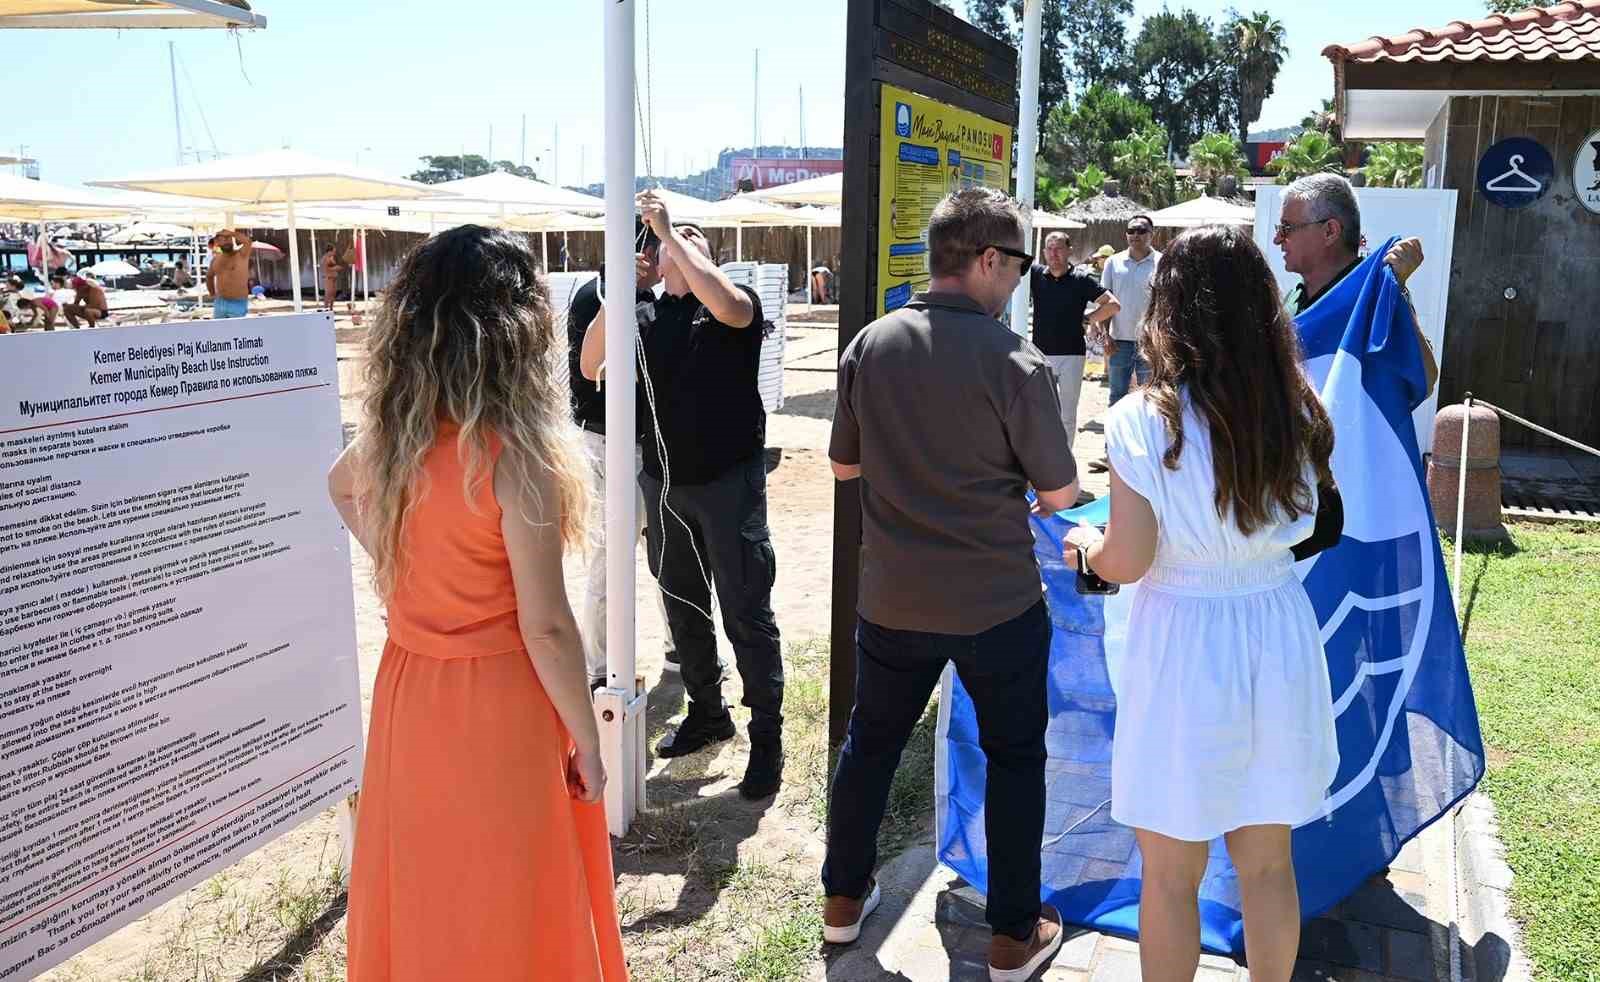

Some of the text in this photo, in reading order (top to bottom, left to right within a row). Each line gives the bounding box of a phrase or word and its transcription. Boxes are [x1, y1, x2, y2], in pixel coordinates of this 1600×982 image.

[94, 336, 263, 364] Kemer Belediyesi Plaj Kullanım Talimatı
[90, 354, 269, 385] Kemer Municipality Beach Use Instruction
[19, 393, 111, 418] Муниципальитет
[114, 389, 148, 405] города
[149, 384, 179, 398] Кемер
[180, 379, 219, 396] Правила
[220, 378, 231, 388] по
[232, 370, 294, 386] использованию
[1, 438, 94, 458] masks in separate boxes
[15, 484, 48, 498] of social
[25, 526, 51, 537] smoke
[52, 523, 62, 531] on
[63, 520, 76, 528] the
[76, 514, 101, 525] beach.
[131, 504, 143, 513] the
[39, 512, 63, 523] dikkat
[12, 566, 51, 581] relaxation
[52, 562, 66, 571] use
[67, 559, 79, 567] the
[4, 616, 20, 625] use
[9, 653, 30, 665] enter
[31, 649, 44, 658] the
[45, 644, 59, 653] sea
[60, 641, 68, 649] in
[3, 700, 13, 708] to
[14, 694, 31, 705] stay
[41, 686, 54, 695] the
[55, 677, 77, 690] beach
[78, 664, 112, 681] overnight
[33, 726, 49, 738] into
[49, 722, 61, 732] the
[77, 708, 99, 720] where
[143, 685, 158, 695] high
[24, 812, 37, 822] the
[38, 802, 60, 816] entire
[60, 791, 83, 805] beach
[92, 770, 127, 792] monitored
[47, 918, 76, 937] Thank
[77, 908, 95, 924] you
[96, 900, 109, 912] for
[111, 889, 130, 906] your
[131, 866, 172, 893] sensitivity
[173, 861, 182, 870] to
[183, 853, 195, 864] the
[196, 834, 231, 857] measures
[232, 821, 252, 837] taken
[252, 818, 260, 826] to
[260, 803, 284, 823] protect
[71, 884, 115, 912] korumaya
[37, 943, 56, 958] Вас
[58, 936, 68, 947] за
